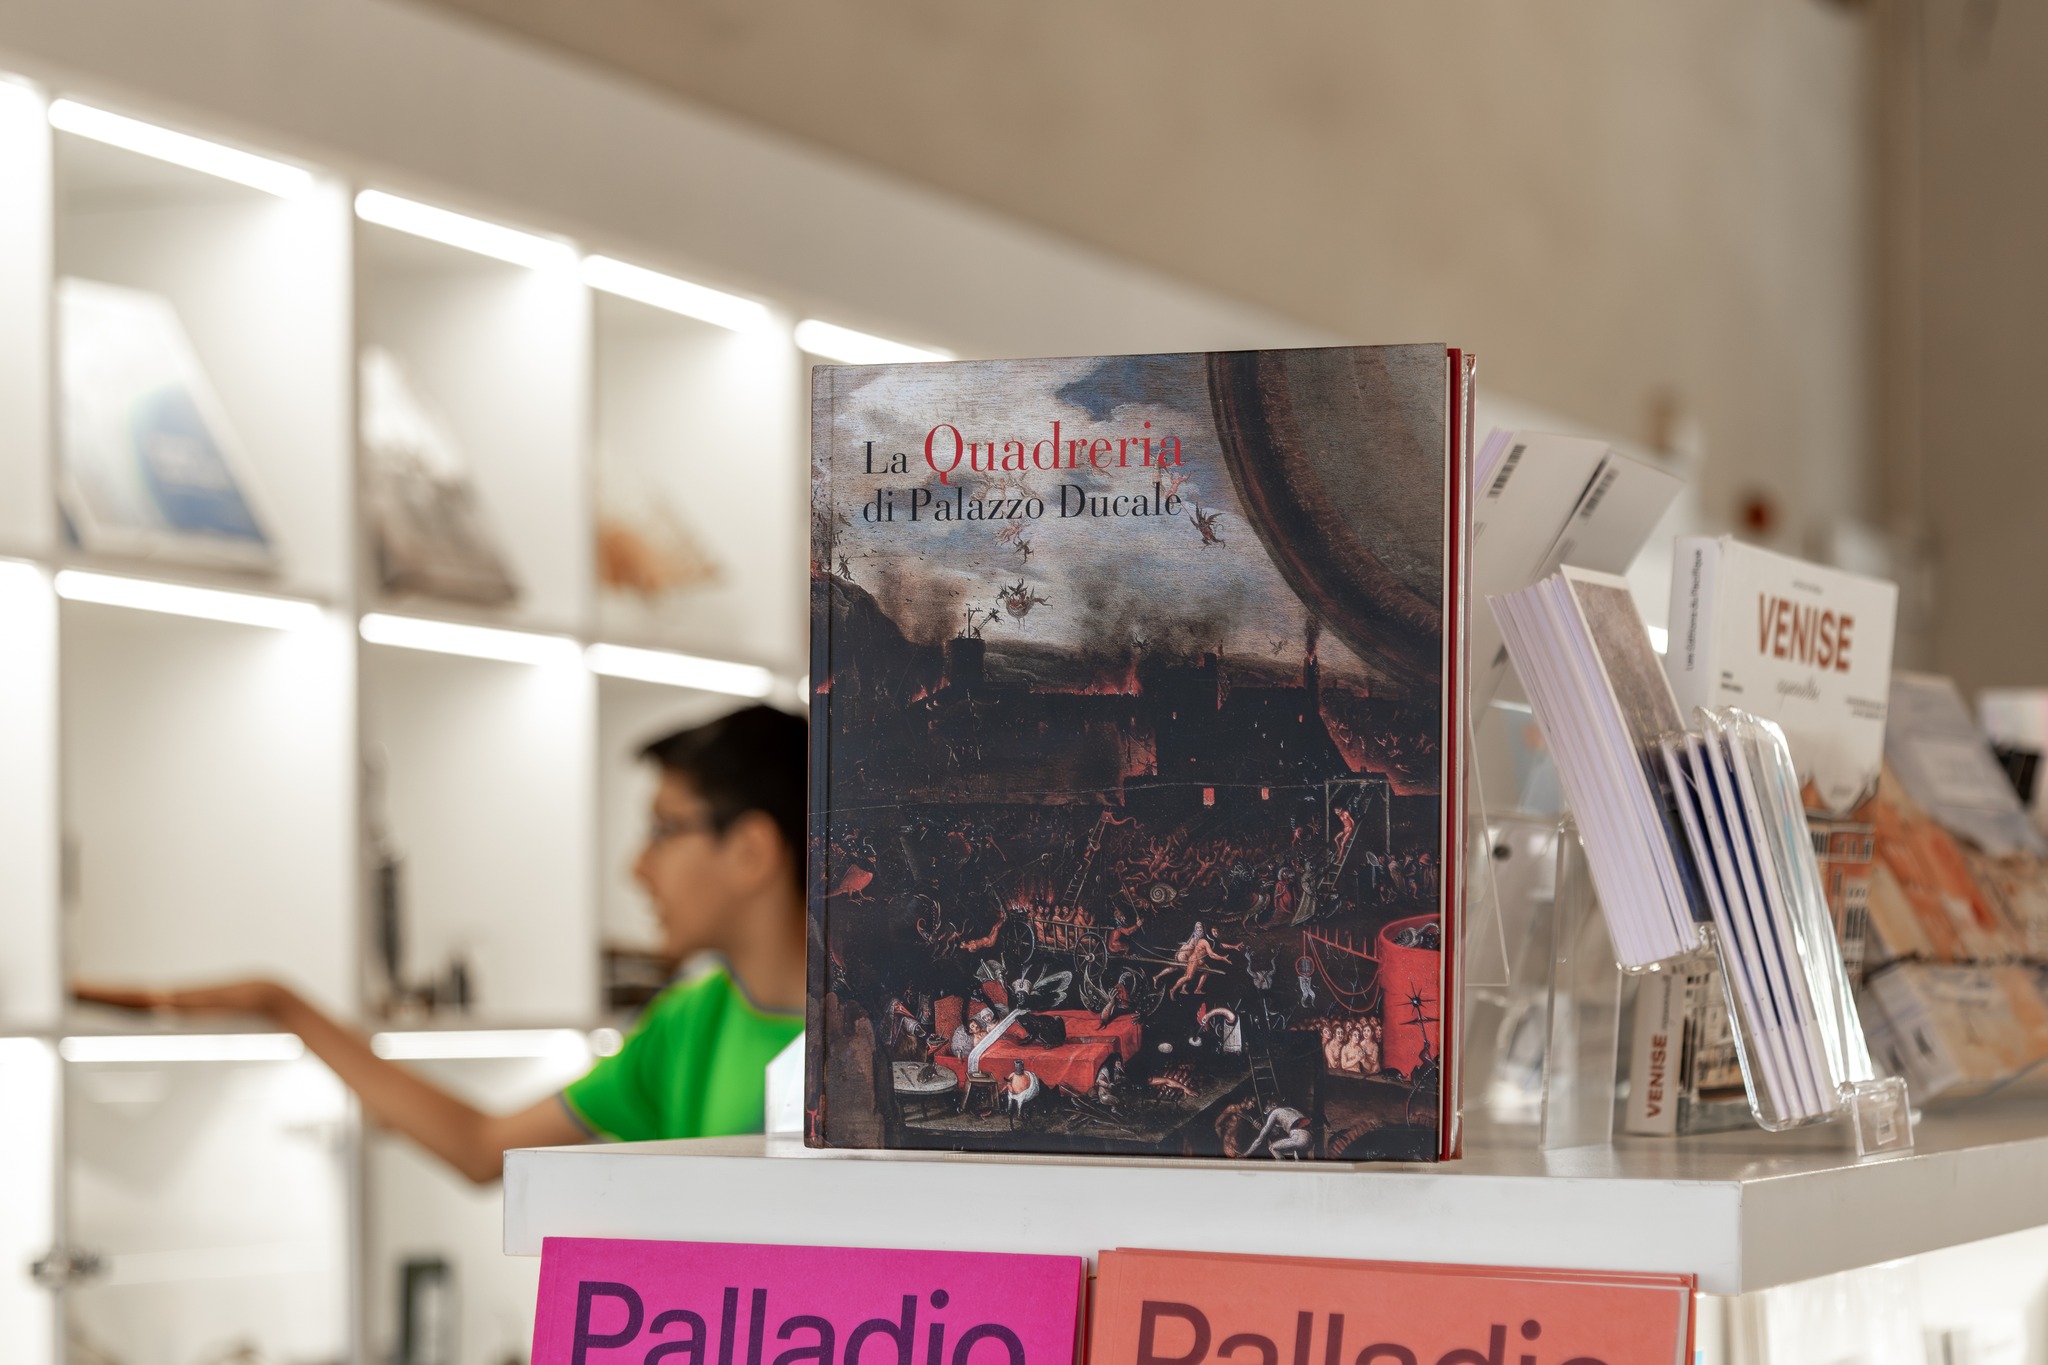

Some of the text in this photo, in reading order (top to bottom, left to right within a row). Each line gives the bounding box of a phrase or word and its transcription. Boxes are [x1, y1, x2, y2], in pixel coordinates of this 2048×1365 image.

[862, 419, 1188, 488] La Quadreria
[862, 481, 1183, 523] di Palazzo Ducale
[1759, 592, 1854, 672] VENISE
[1646, 1034, 1668, 1119] VENISE
